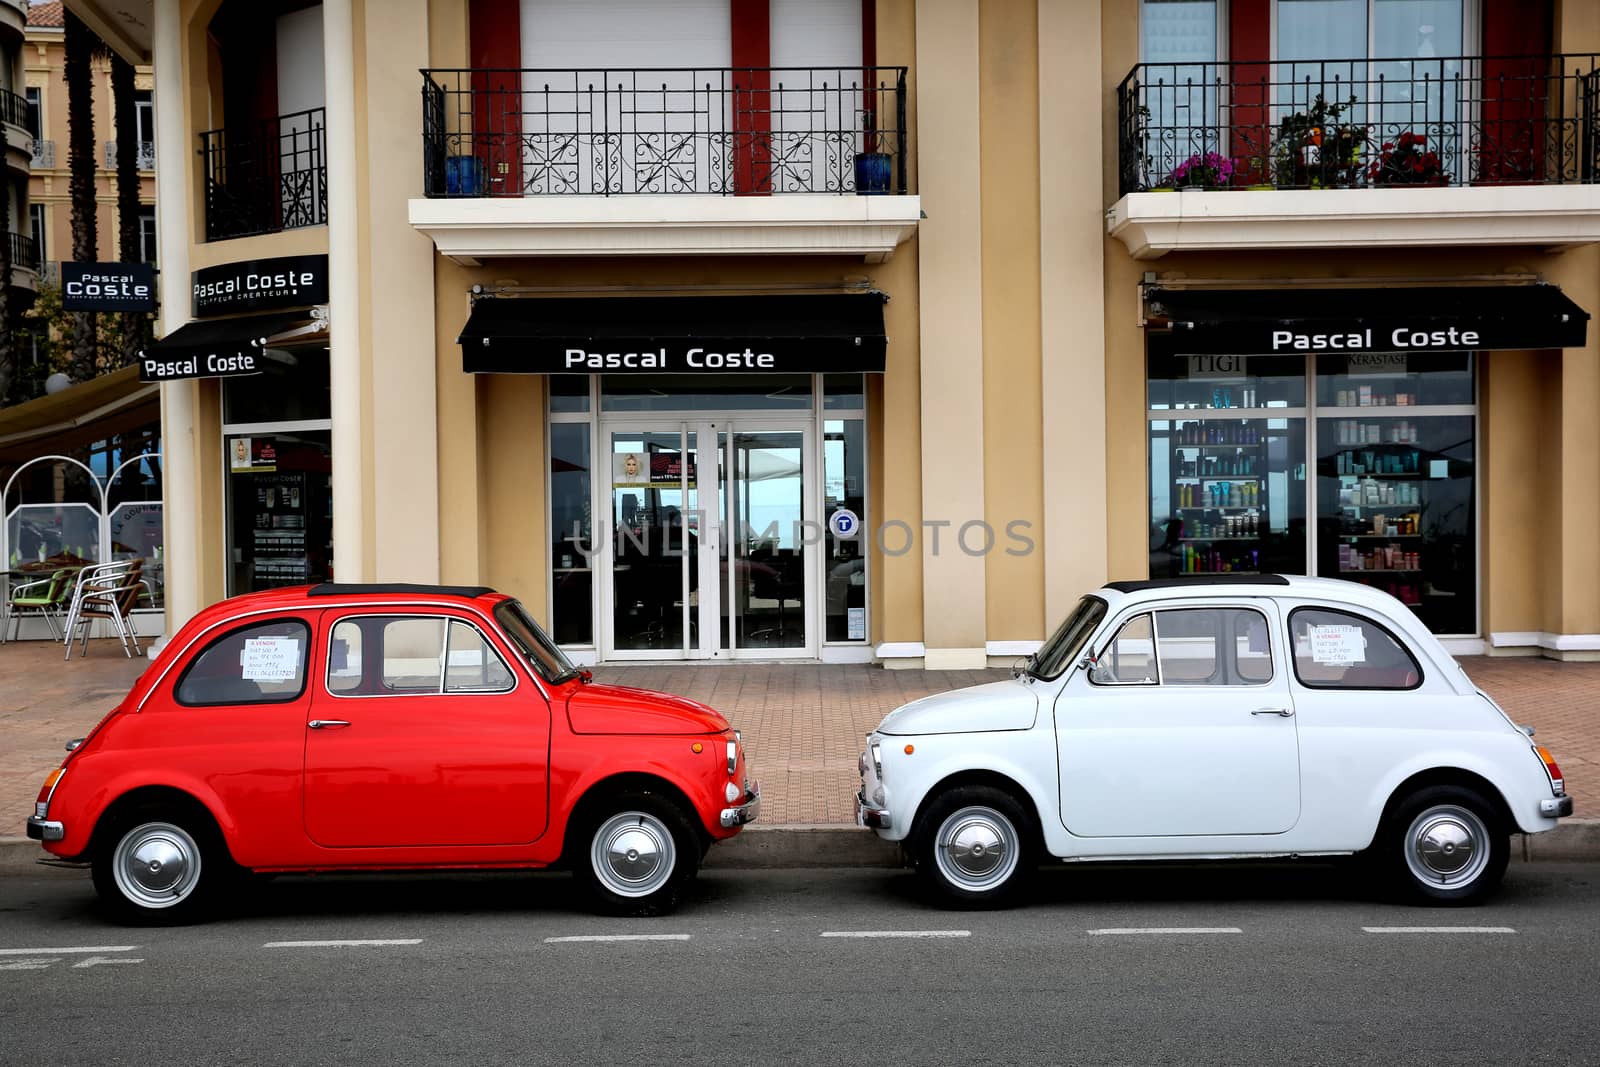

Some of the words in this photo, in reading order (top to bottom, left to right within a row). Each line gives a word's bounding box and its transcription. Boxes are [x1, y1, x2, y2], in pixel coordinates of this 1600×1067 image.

[67, 282, 149, 296] Coste
[82, 274, 134, 283] Pascal
[193, 276, 240, 299] Pascal
[247, 271, 314, 290] Coste
[1272, 328, 1372, 350] Pascal
[1391, 327, 1480, 347] Coste
[144, 356, 198, 377] Pascal
[207, 352, 255, 372] Coste
[565, 348, 666, 369] Pascal
[686, 348, 775, 368] Coste
[1192, 355, 1241, 372] TIGI
